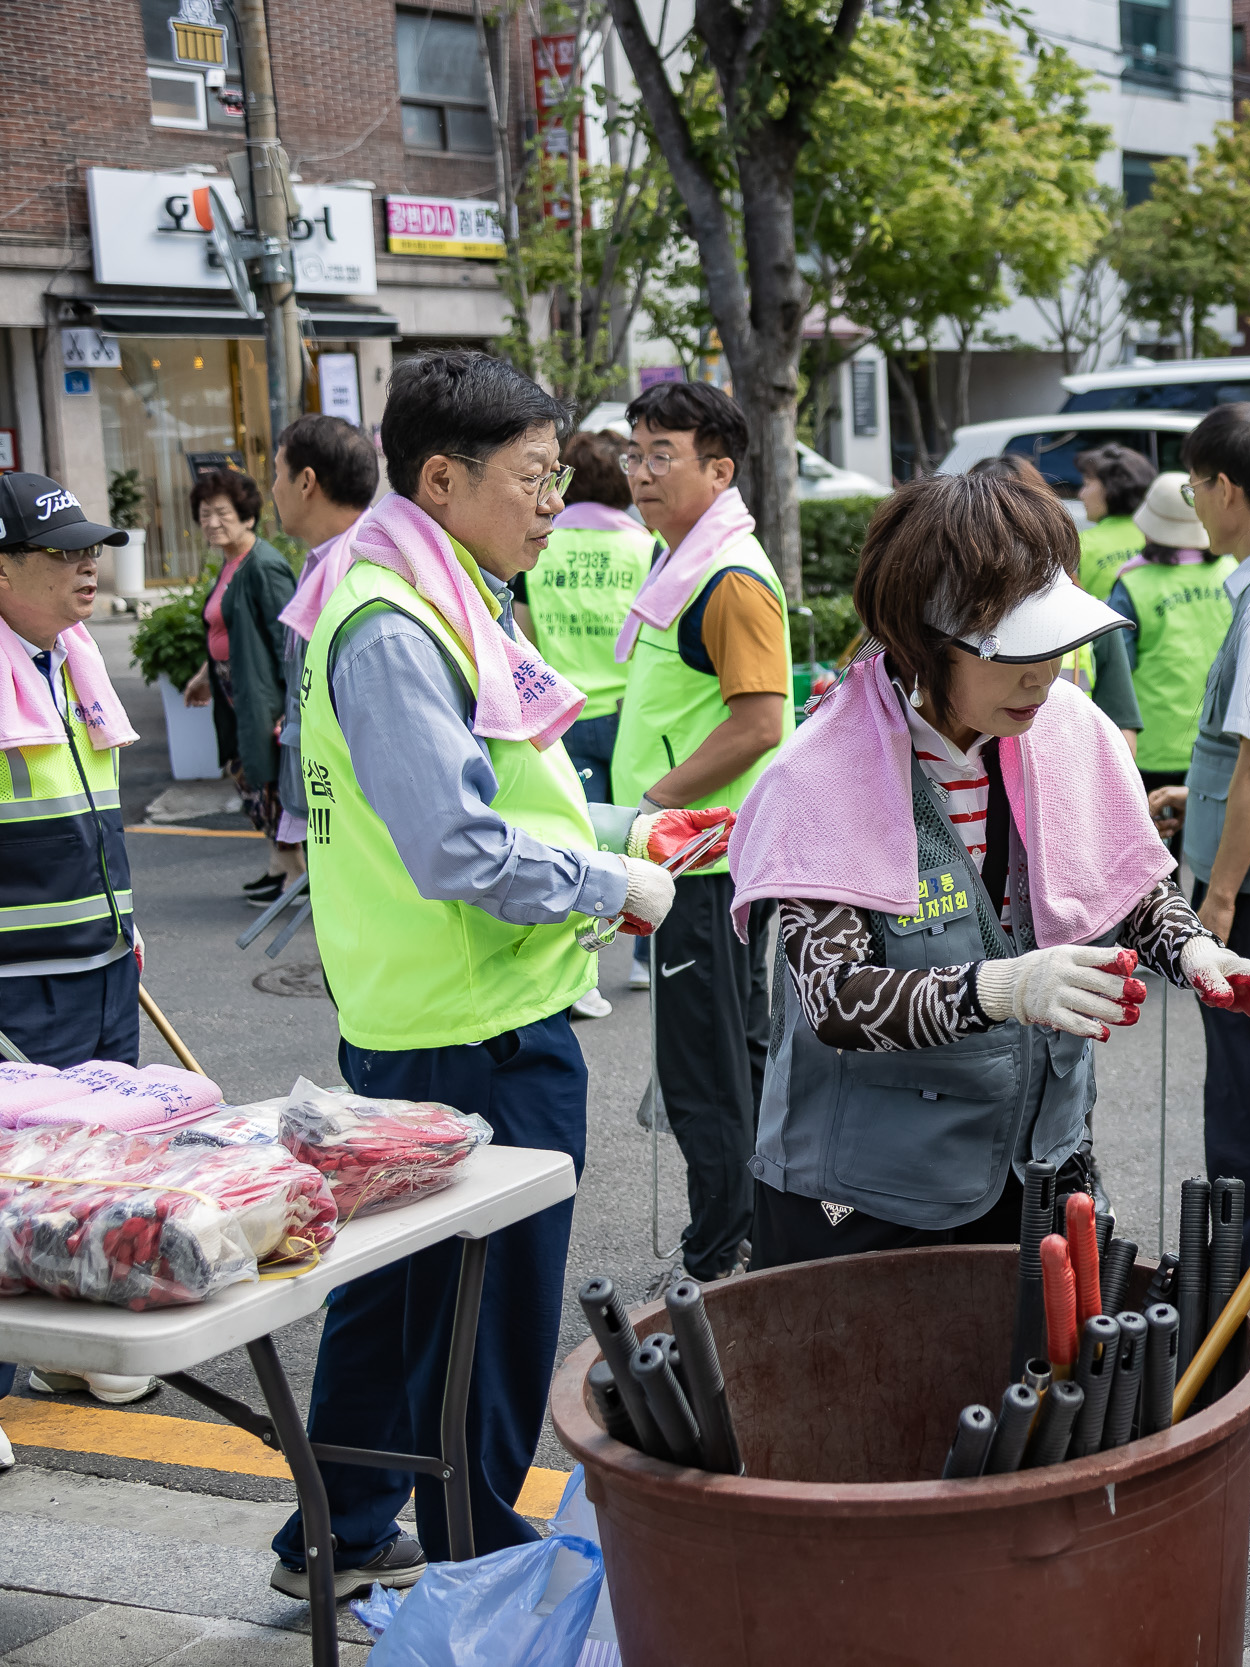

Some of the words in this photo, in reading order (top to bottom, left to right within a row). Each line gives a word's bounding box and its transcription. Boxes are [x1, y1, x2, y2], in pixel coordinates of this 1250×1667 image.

[566, 551, 611, 569] 구의3동
[543, 570, 634, 589] 자율청소봉사단
[520, 671, 557, 713] 의3동
[918, 873, 954, 898] 의3동
[825, 1203, 849, 1214] PRADA
